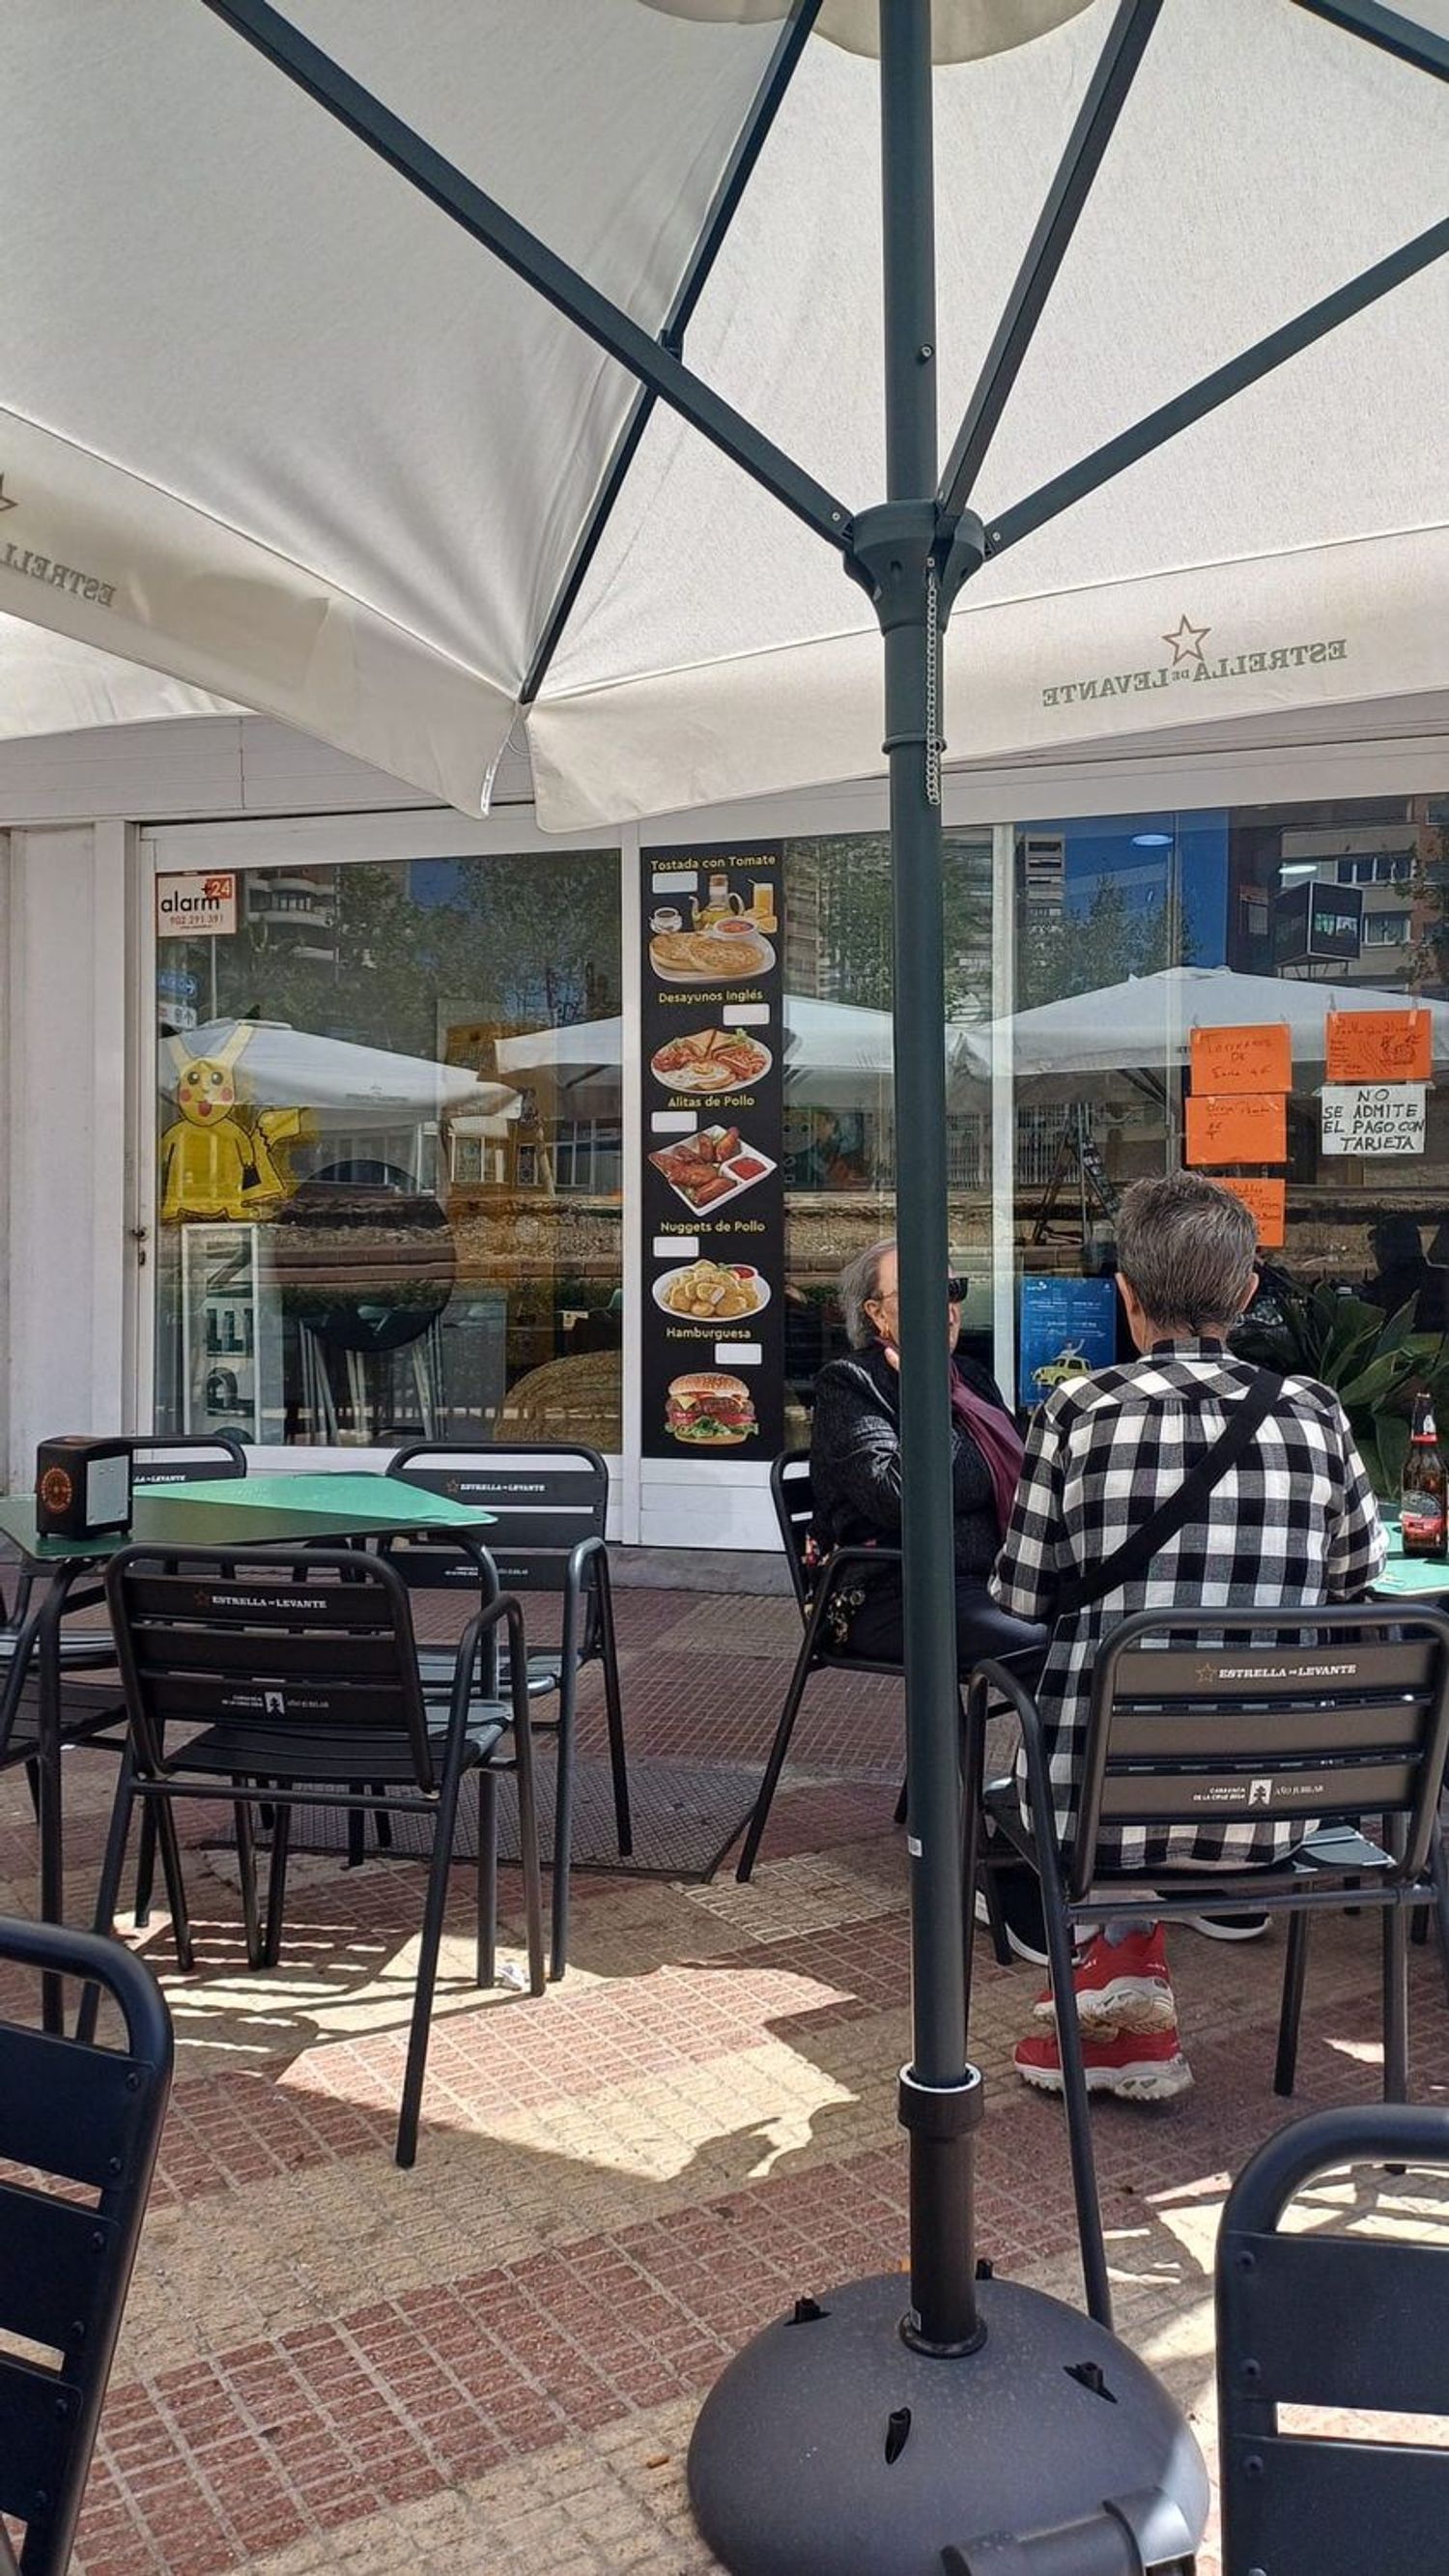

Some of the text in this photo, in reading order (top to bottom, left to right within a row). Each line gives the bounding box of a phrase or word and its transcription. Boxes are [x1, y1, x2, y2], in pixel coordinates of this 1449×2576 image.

[650, 855, 776, 870] Tostada con Tomate
[161, 890, 219, 913] alarm
[659, 989, 763, 1004] Desayunos Inglés
[668, 1094, 755, 1107] Alitas de Pollo
[1357, 1089, 1390, 1102] NO
[1322, 1103, 1418, 1119] SE ADMITE
[1323, 1119, 1425, 1134] EL PAGO CON
[1340, 1135, 1415, 1151] TARJETA
[661, 1219, 765, 1235] Nuggets de Pollo
[667, 1327, 752, 1340] Hamburguesa
[213, 1595, 267, 1607] ESTRELLA
[276, 1598, 327, 1609] LEVANTE
[1219, 1668, 1287, 1679] ESTRELLA
[1297, 1664, 1357, 1676] LEVANTE
